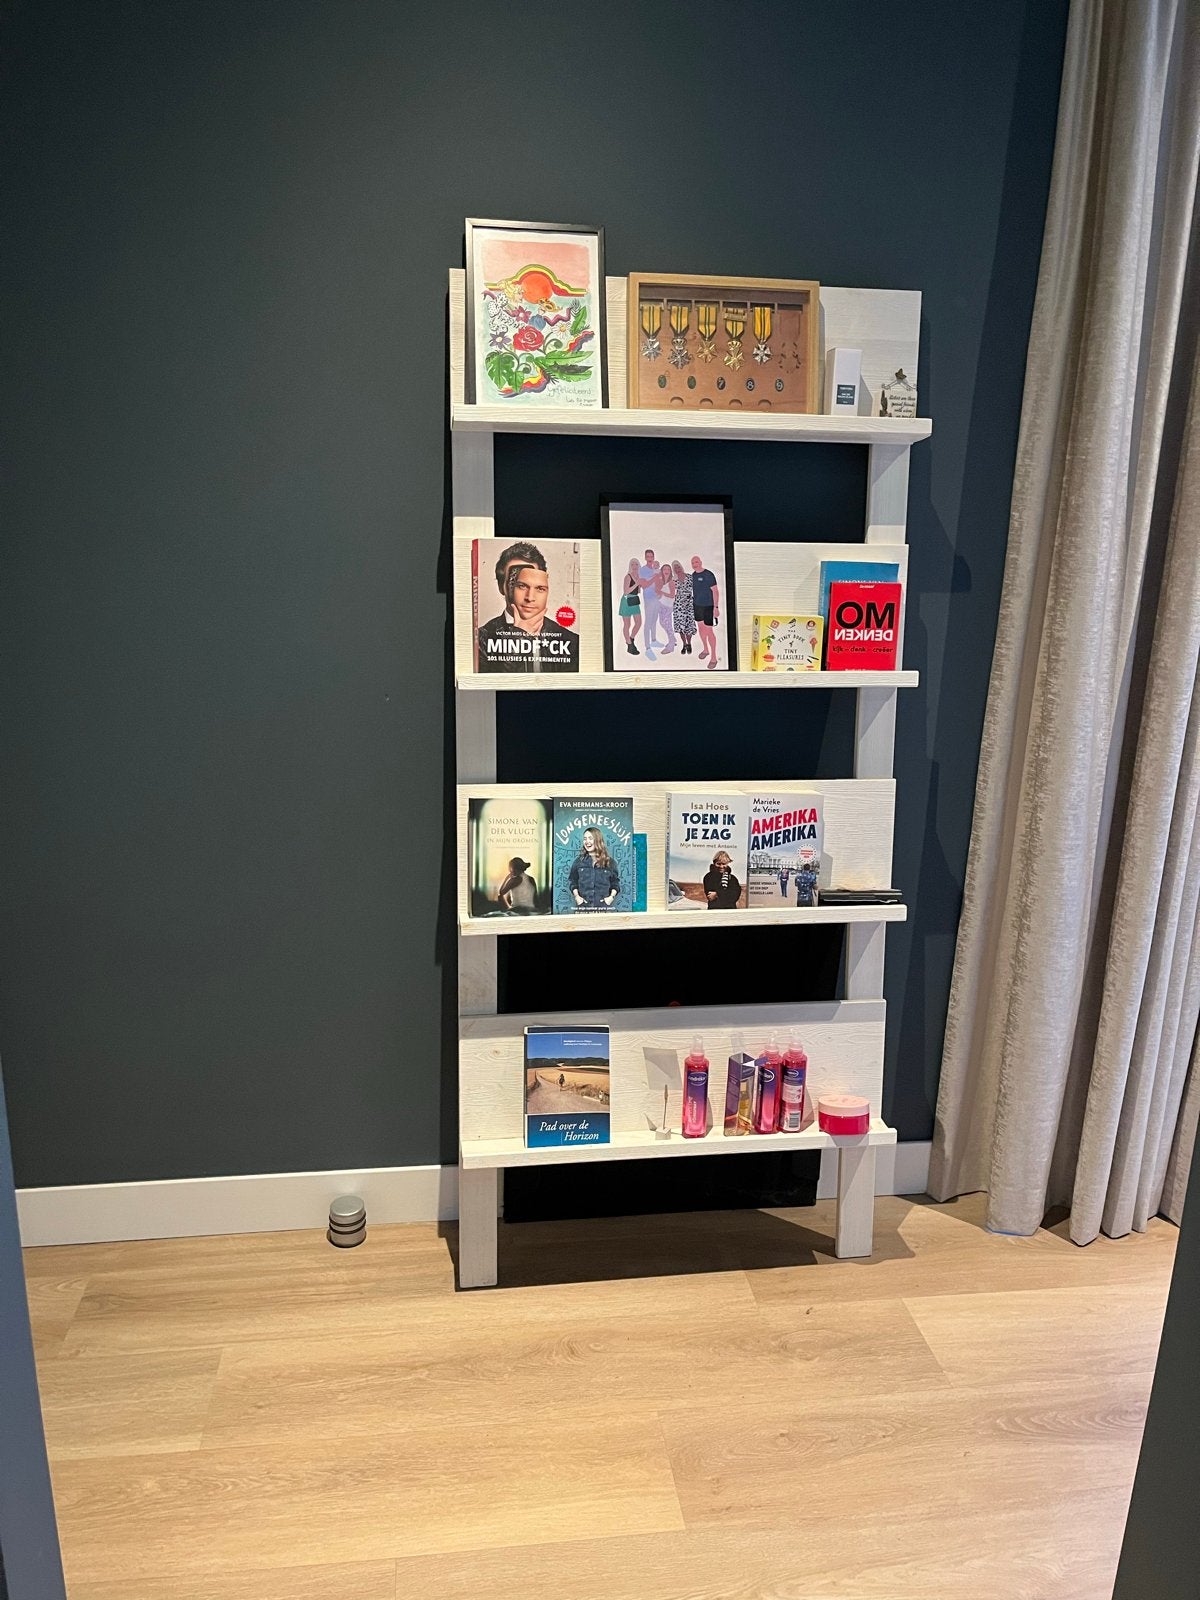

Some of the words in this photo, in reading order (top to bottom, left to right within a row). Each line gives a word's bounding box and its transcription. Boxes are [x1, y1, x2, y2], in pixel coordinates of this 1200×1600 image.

[835, 601, 896, 629] OM
[690, 802, 704, 810] Isa
[706, 802, 729, 811] Hoes
[488, 817, 519, 825] SIMONE
[681, 812, 719, 825] TOEN
[722, 813, 736, 826] IK
[751, 808, 818, 835] AMERIKA
[685, 827, 698, 842] JE
[701, 828, 731, 841] ZAG
[750, 824, 817, 851] AMERIKA
[539, 1120, 557, 1132] Pad
[559, 1121, 576, 1131] over
[578, 1119, 589, 1130] de
[564, 1131, 600, 1141] Horizon
